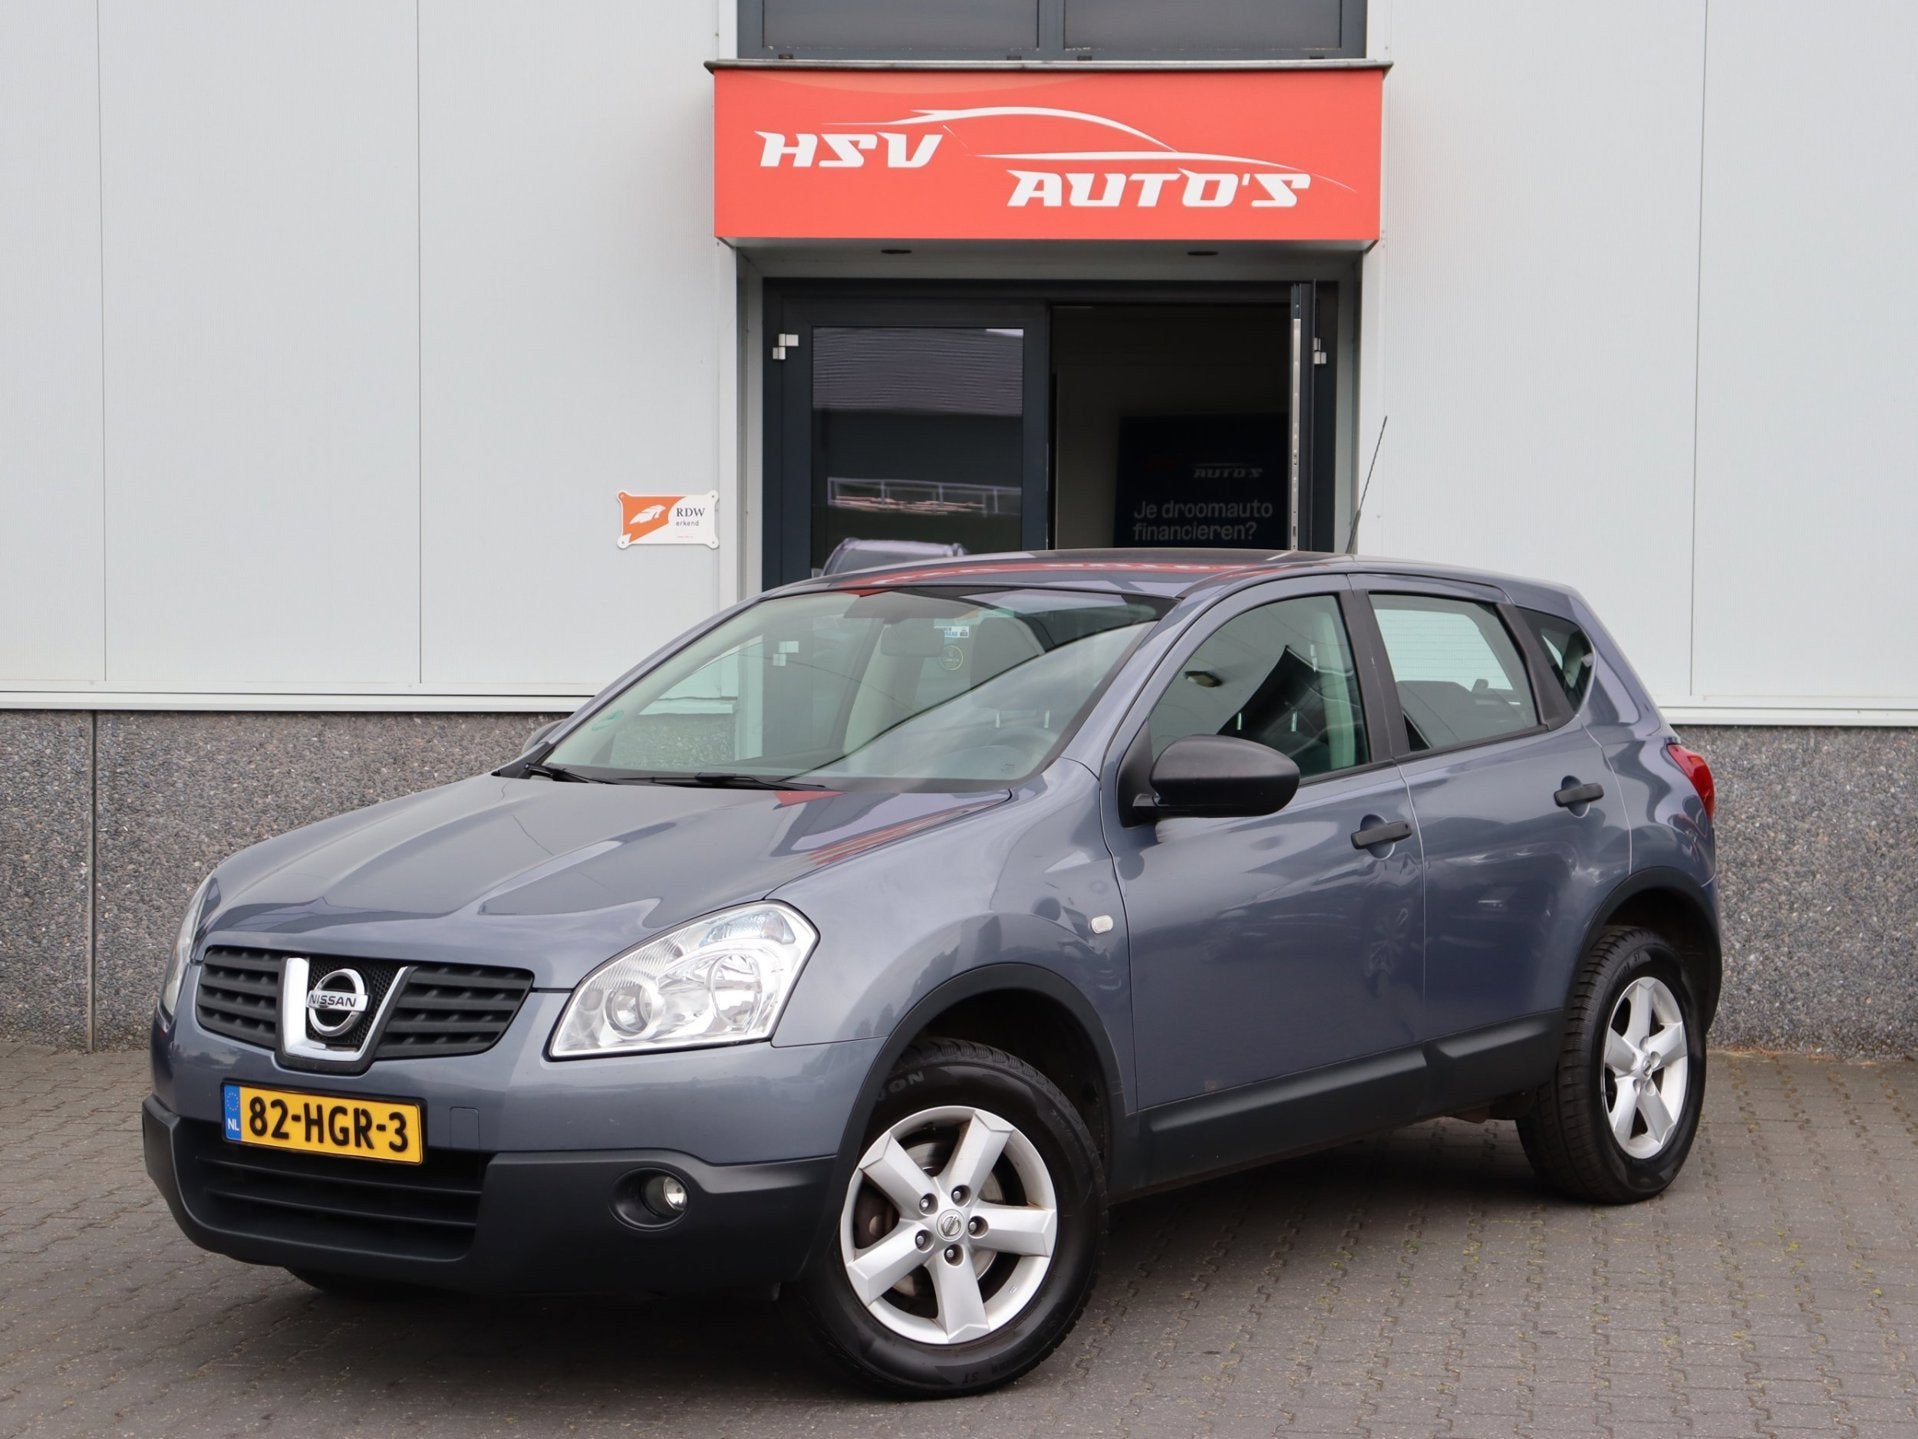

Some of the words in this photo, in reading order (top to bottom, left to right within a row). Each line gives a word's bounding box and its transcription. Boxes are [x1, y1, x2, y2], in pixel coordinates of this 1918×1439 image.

[754, 130, 943, 168] HSV
[1006, 167, 1311, 208] AUTO'S
[675, 506, 706, 518] RDW
[1133, 501, 1158, 519] Je
[1161, 500, 1274, 519] droomauto
[675, 519, 700, 527] erkend
[1132, 521, 1258, 541] financieren?
[308, 993, 357, 1008] NISSAN
[227, 1118, 240, 1131] NL
[249, 1096, 409, 1153] 82-HGR-3
